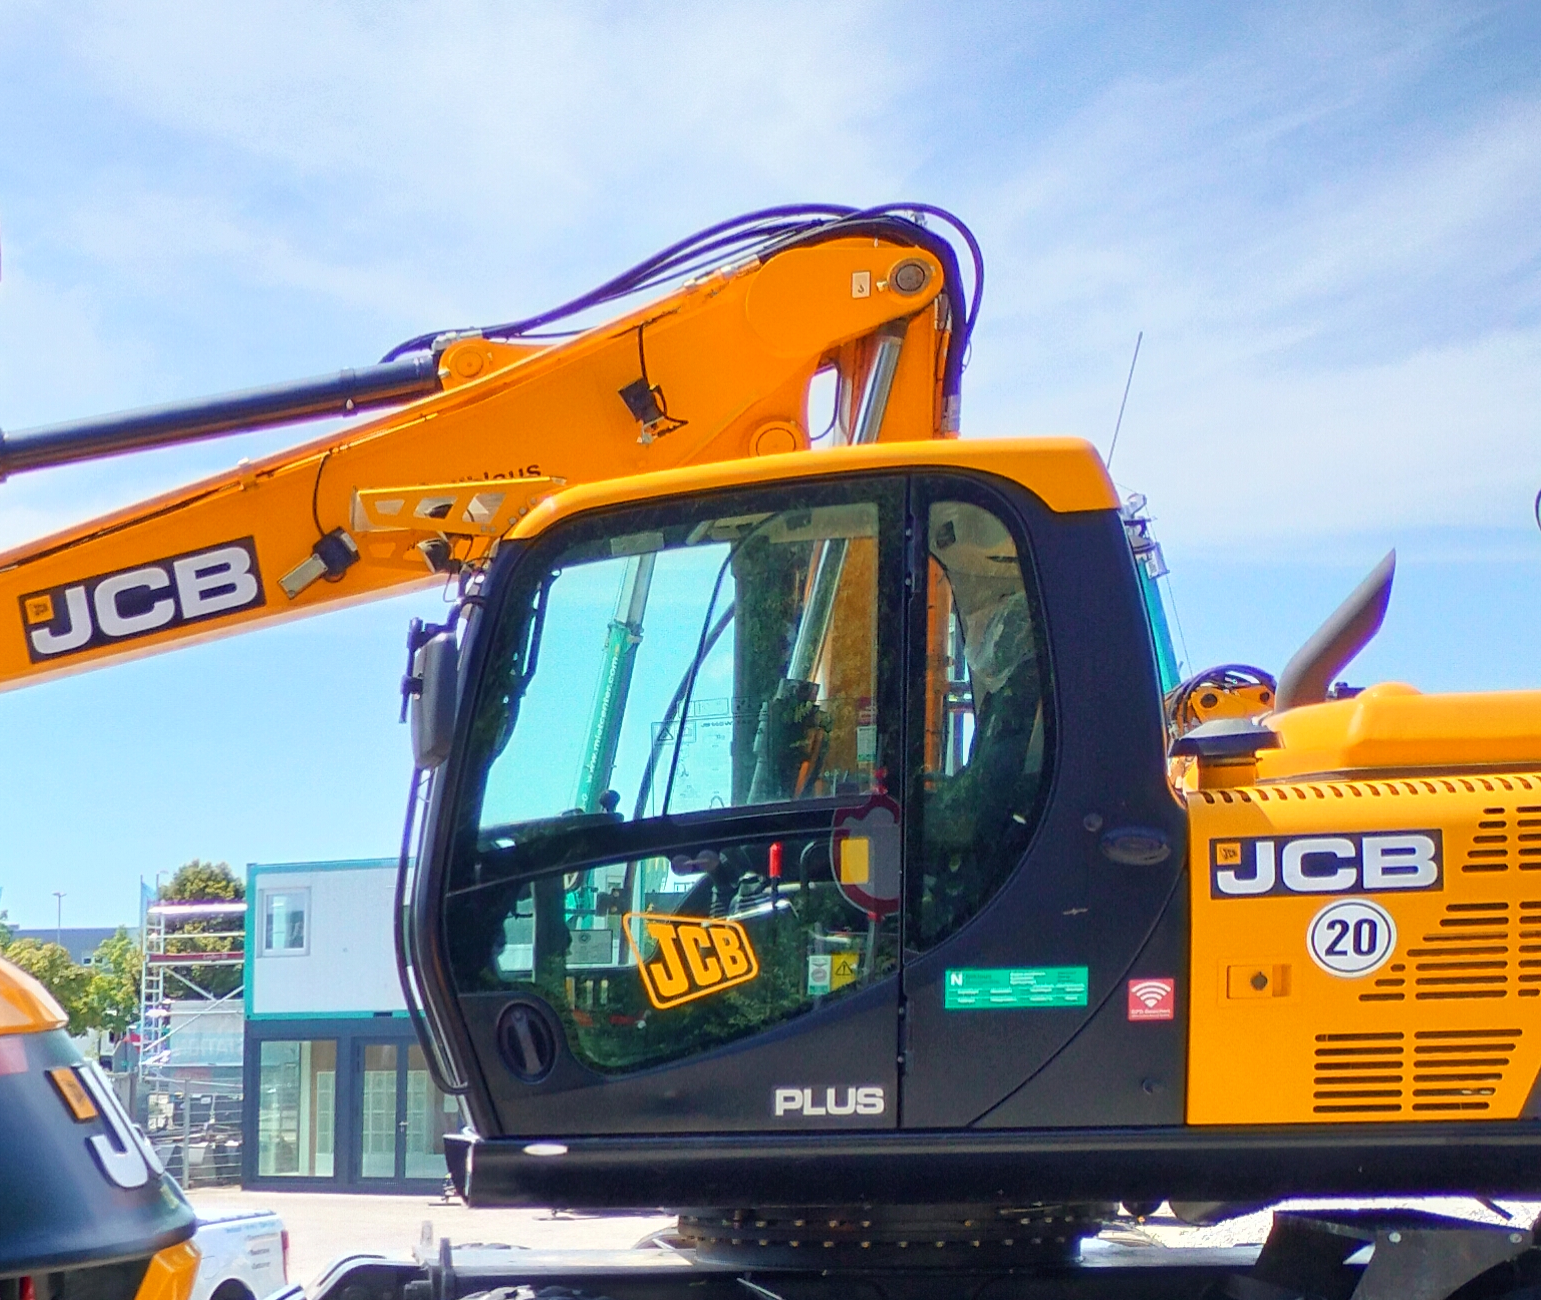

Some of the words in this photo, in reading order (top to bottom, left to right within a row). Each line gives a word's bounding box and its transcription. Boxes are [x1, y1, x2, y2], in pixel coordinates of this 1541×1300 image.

[31, 547, 258, 654] JCB
[1217, 835, 1438, 895] JCB
[647, 923, 748, 997] JCB
[1325, 918, 1378, 956] 20
[775, 1087, 885, 1116] PLUS
